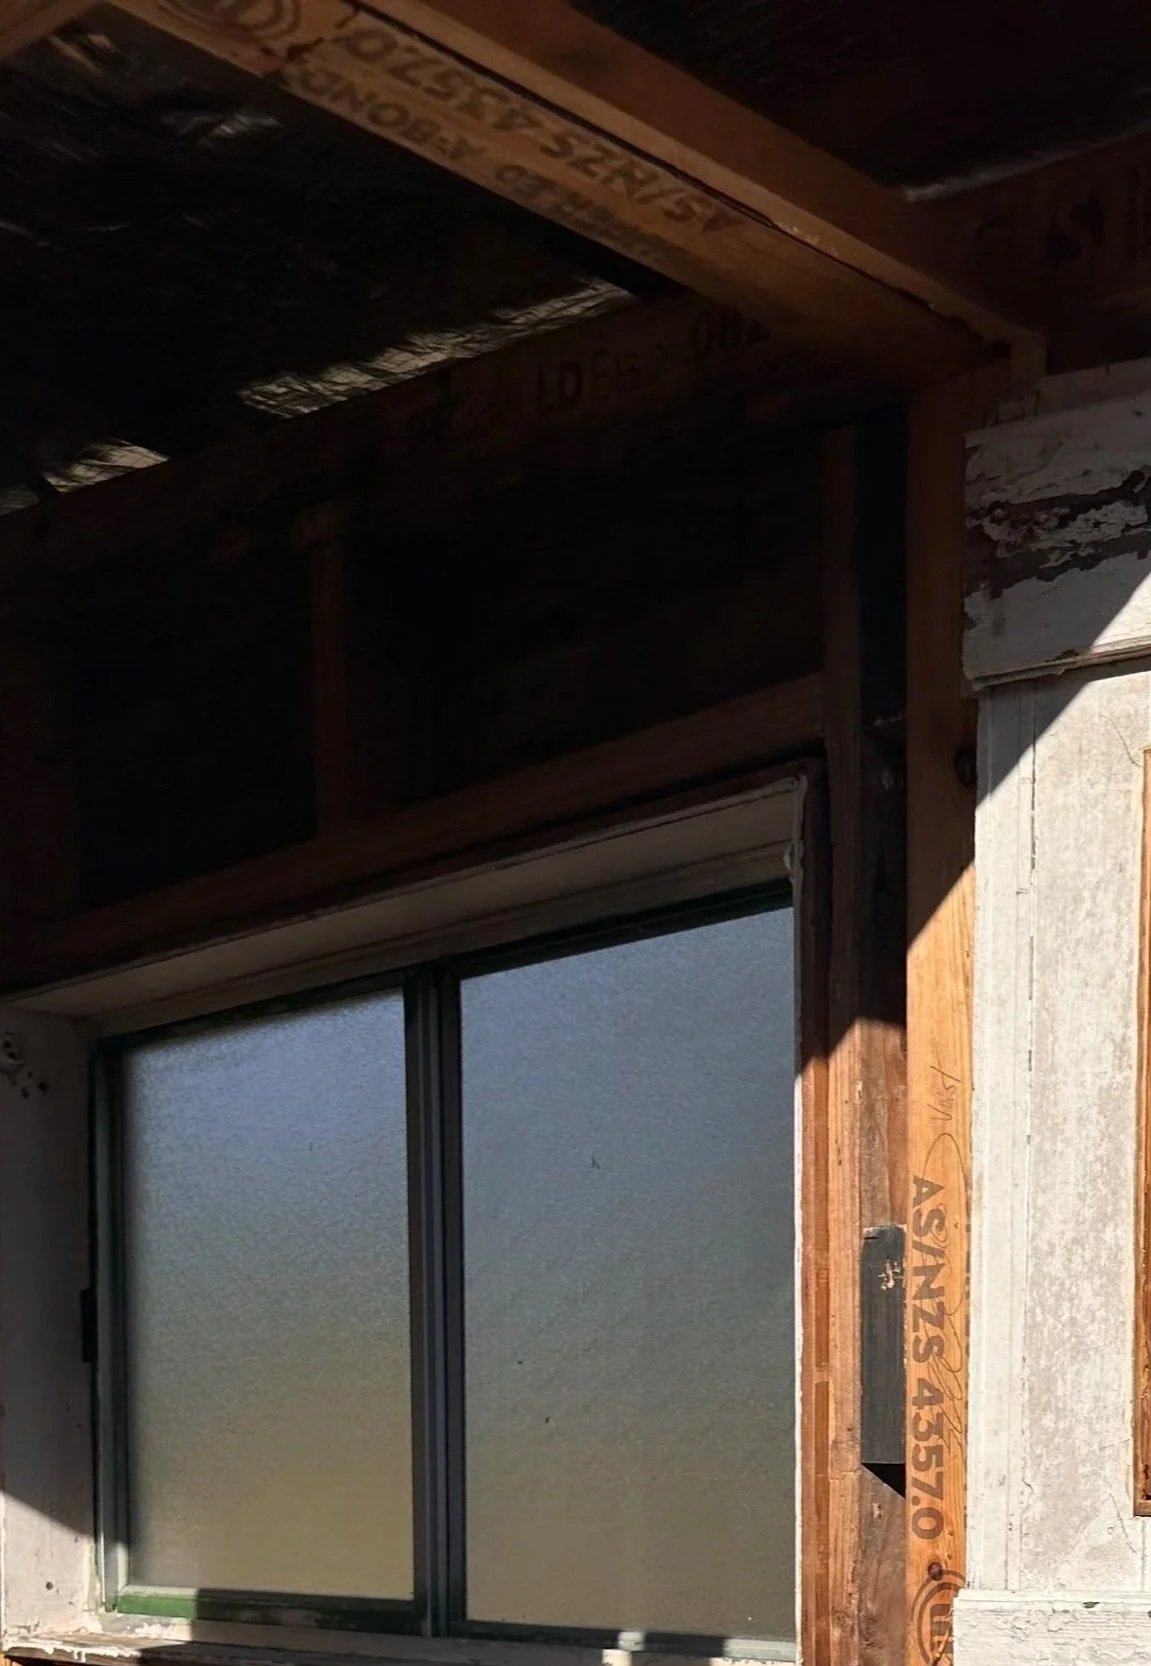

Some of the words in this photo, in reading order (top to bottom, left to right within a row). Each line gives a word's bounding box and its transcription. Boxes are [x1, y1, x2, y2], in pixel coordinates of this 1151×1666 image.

[541, 122, 744, 233] AS/NZS
[910, 1175, 945, 1366] AS/NZS
[910, 1380, 945, 1541] 4357.0
